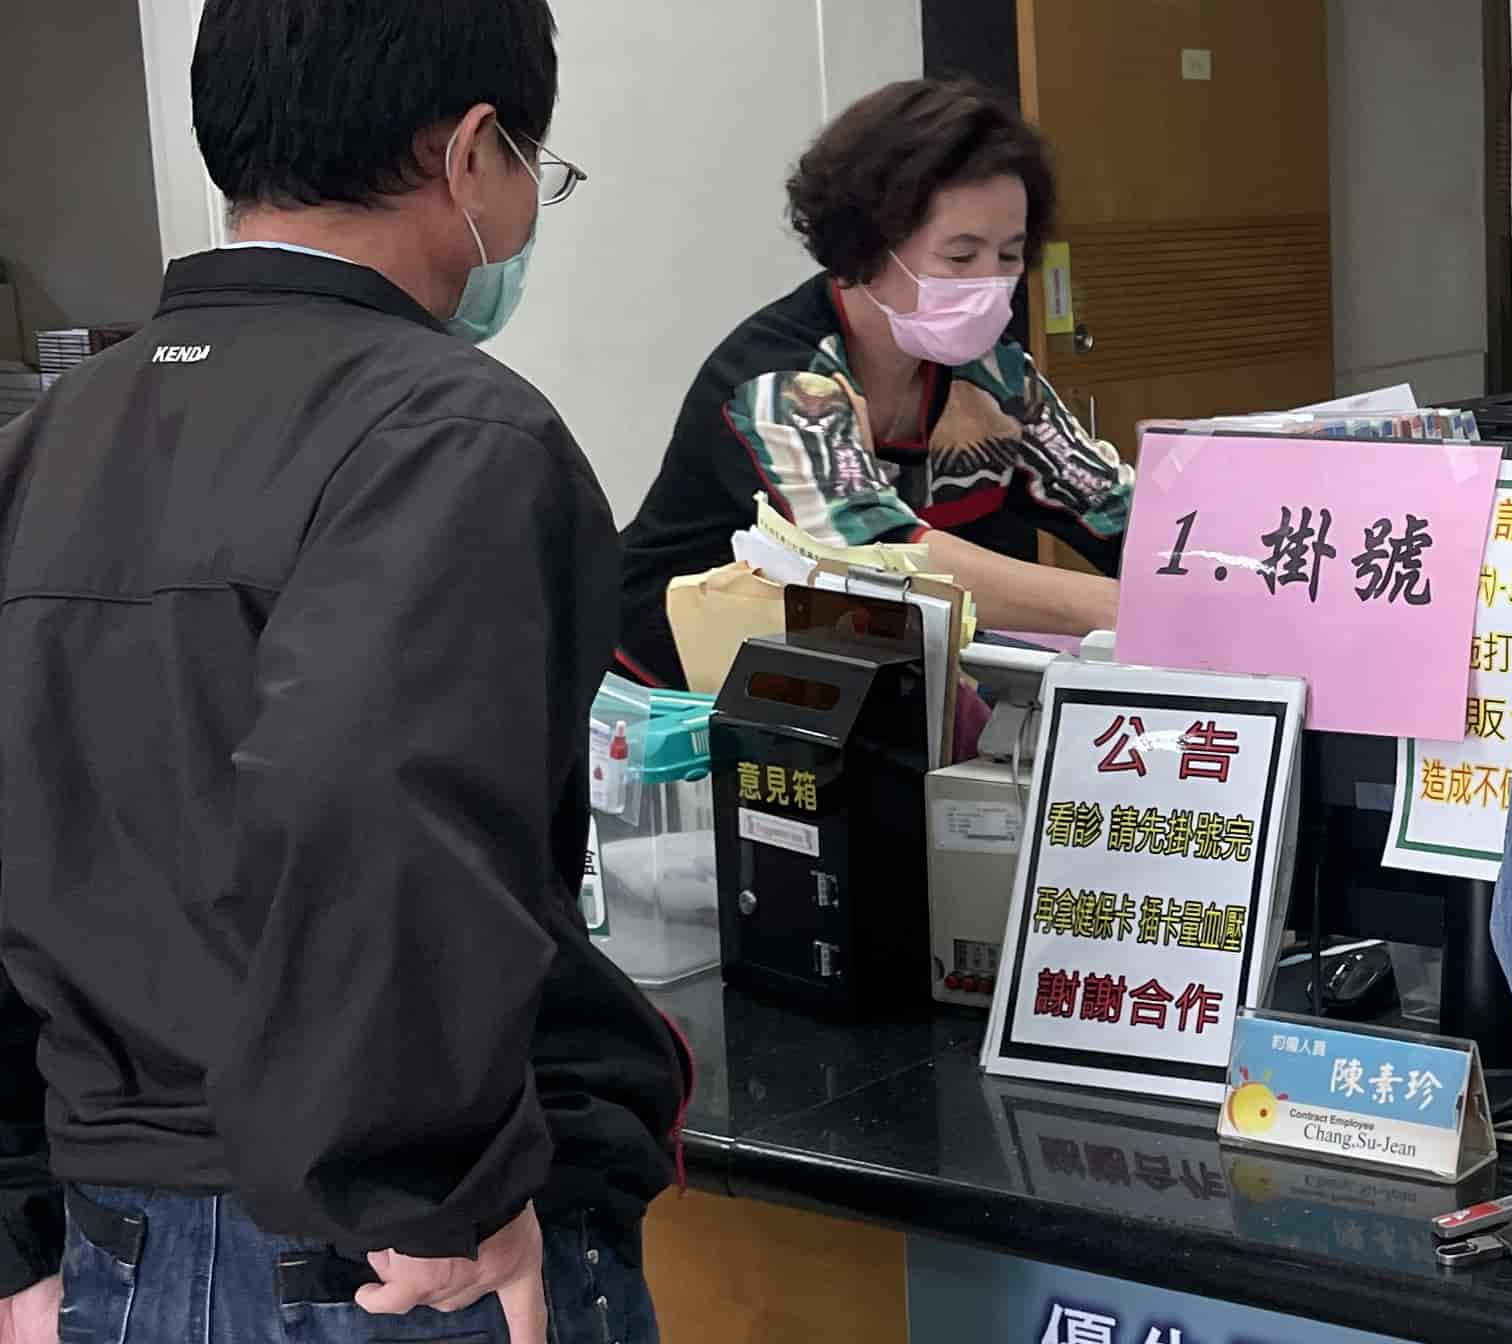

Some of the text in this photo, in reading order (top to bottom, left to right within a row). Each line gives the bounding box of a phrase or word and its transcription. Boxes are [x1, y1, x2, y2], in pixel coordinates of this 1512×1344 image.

[1094, 714, 1240, 783] 公告
[737, 761, 817, 811] 意見箱
[1046, 801, 1104, 848] 看診
[1107, 805, 1254, 861] 請先掛號完
[1033, 886, 1136, 941] 再拿健保卡
[1033, 968, 1224, 1034] 謝謝合作
[1330, 1057, 1443, 1111] 陳素珍
[1289, 1108, 1375, 1132] Contract Employee
